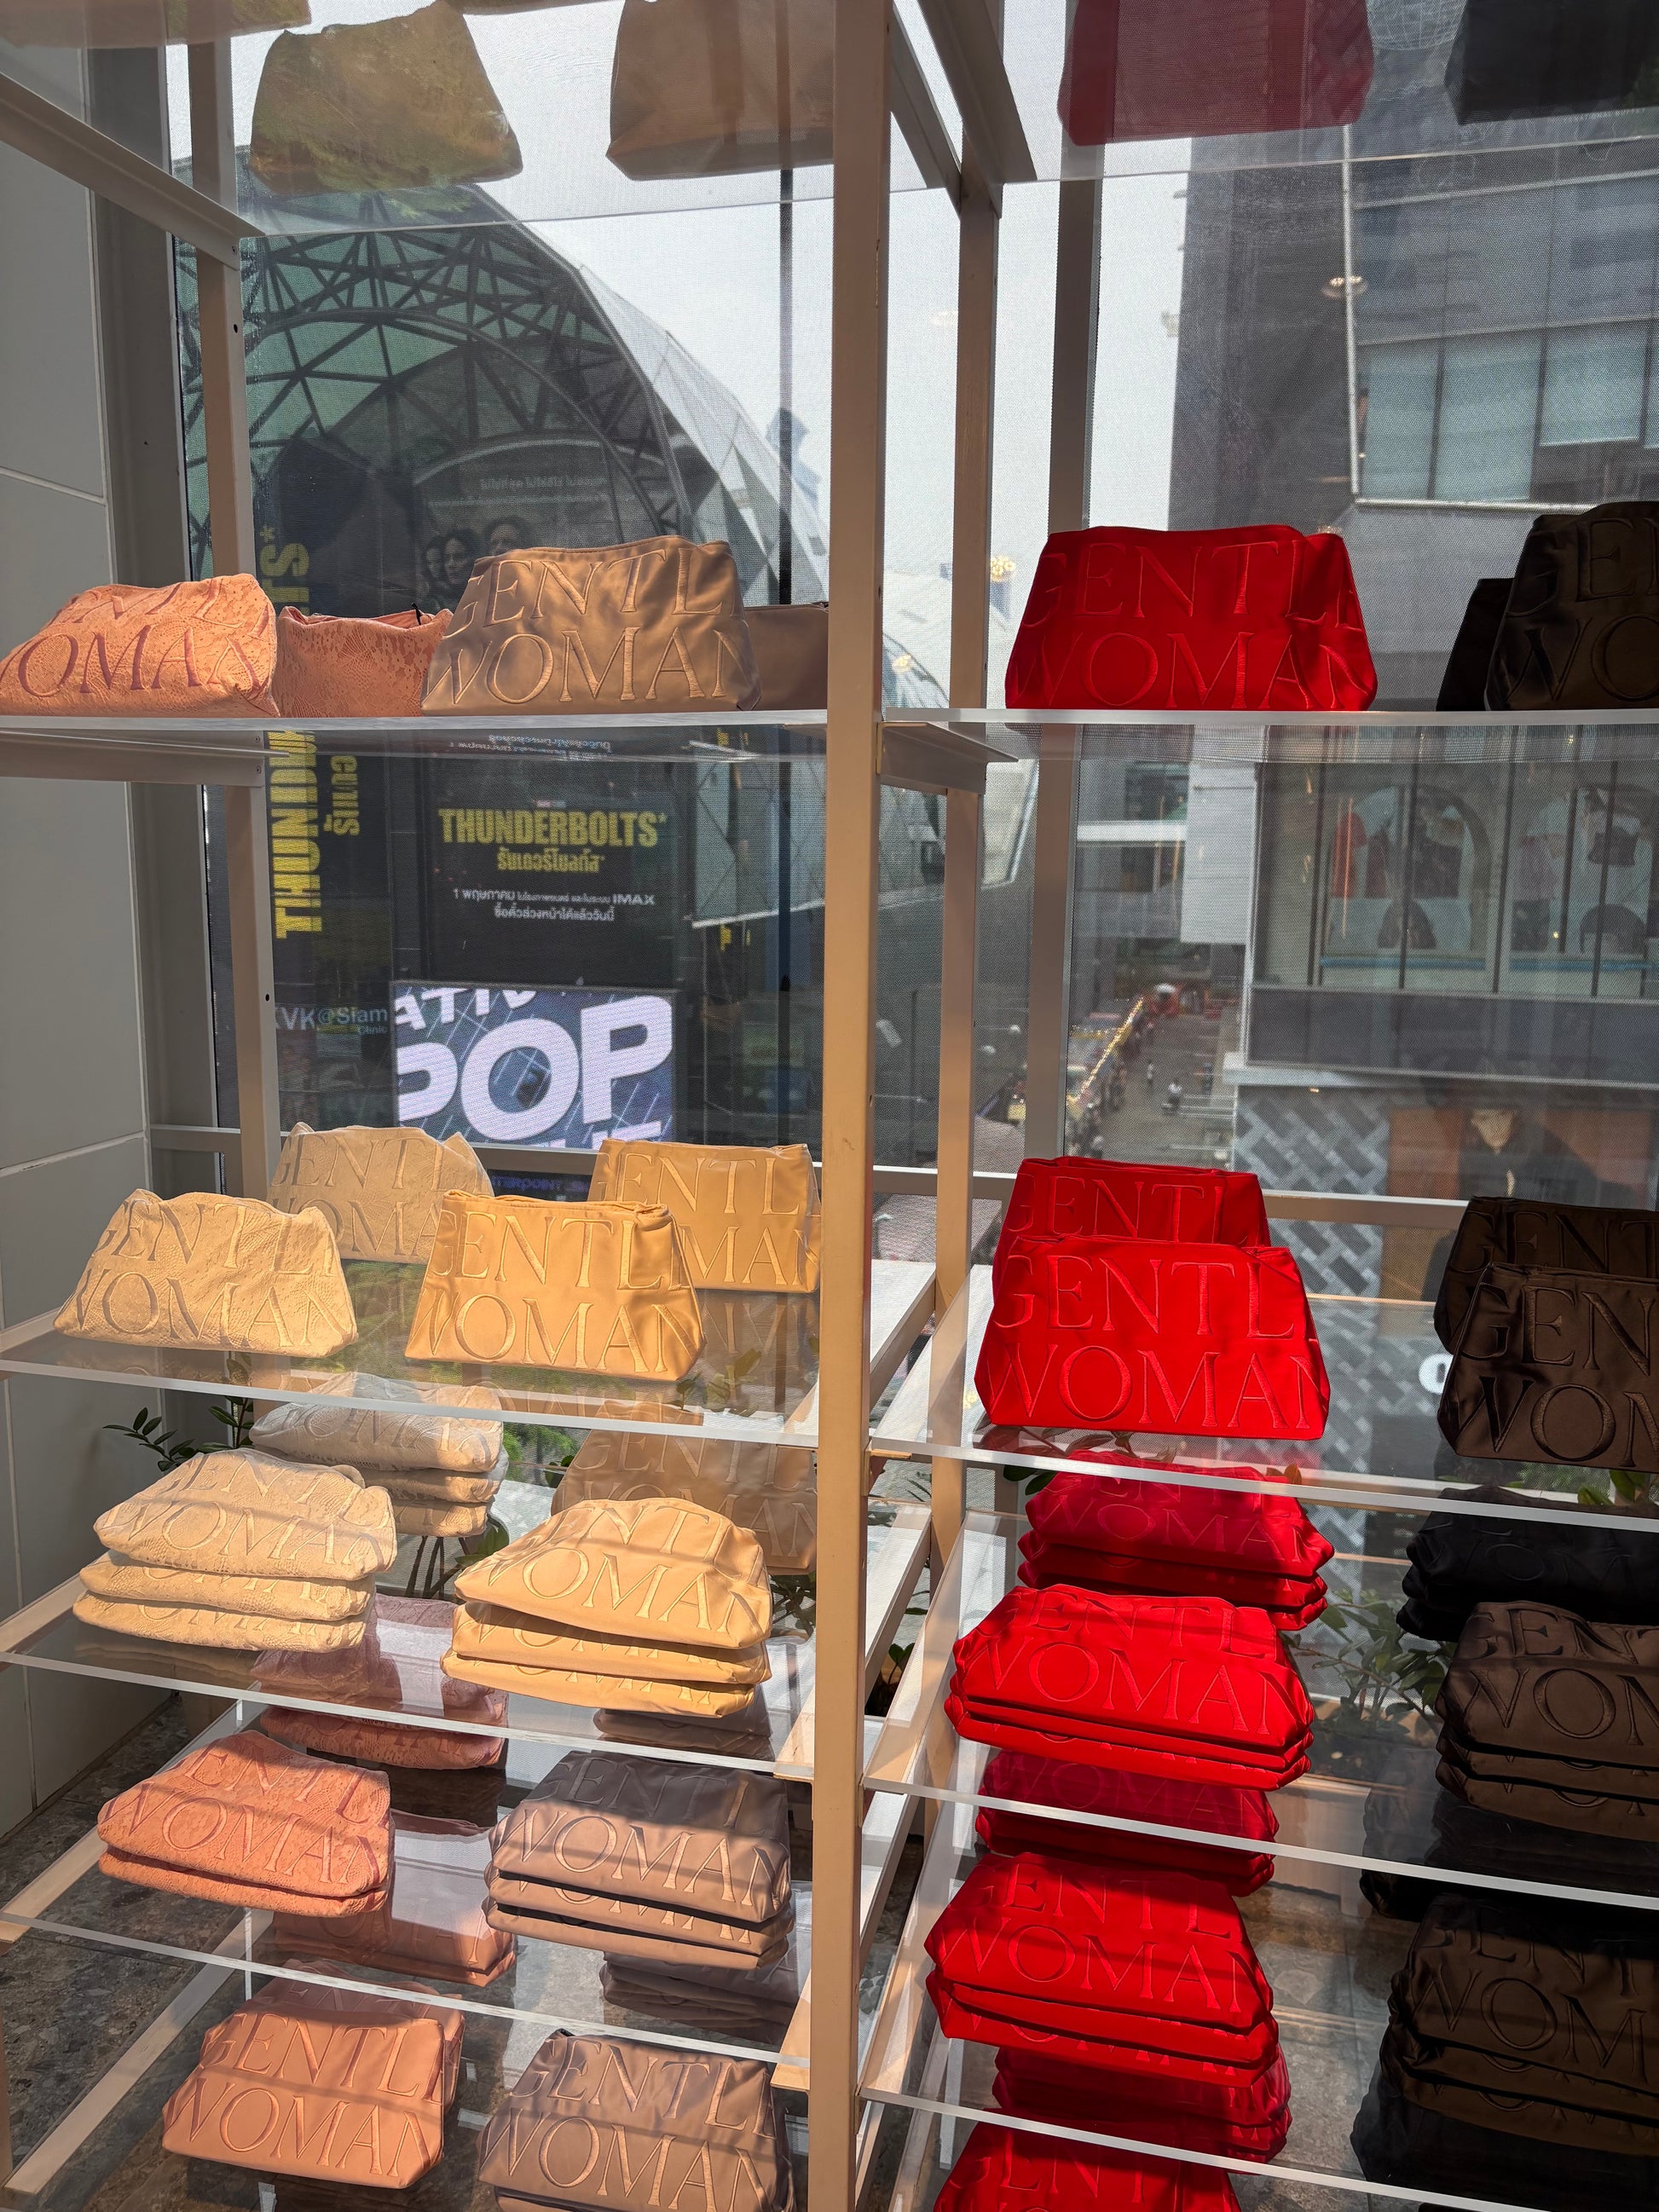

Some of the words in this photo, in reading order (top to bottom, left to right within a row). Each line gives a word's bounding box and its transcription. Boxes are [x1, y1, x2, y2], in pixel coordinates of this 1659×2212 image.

[442, 547, 746, 639] GENTL
[0, 622, 273, 701] OMAN
[423, 626, 755, 706] WOMAN
[1006, 631, 1370, 709] WOMAN
[453, 888, 459, 899] 1
[461, 888, 516, 902] พฤษภาคม
[612, 894, 656, 905] IMAX
[409, 1287, 697, 1372] WOMAN
[987, 1342, 1327, 1430] WOMAN
[962, 1635, 1305, 1735] WOMAN
[103, 1780, 381, 1885] WOMAN
[493, 1808, 782, 1907] WOMAN
[940, 1915, 1269, 2013] WOMAN
[166, 2077, 436, 2178] WOMAN
[479, 2107, 769, 2212] WOMAN
